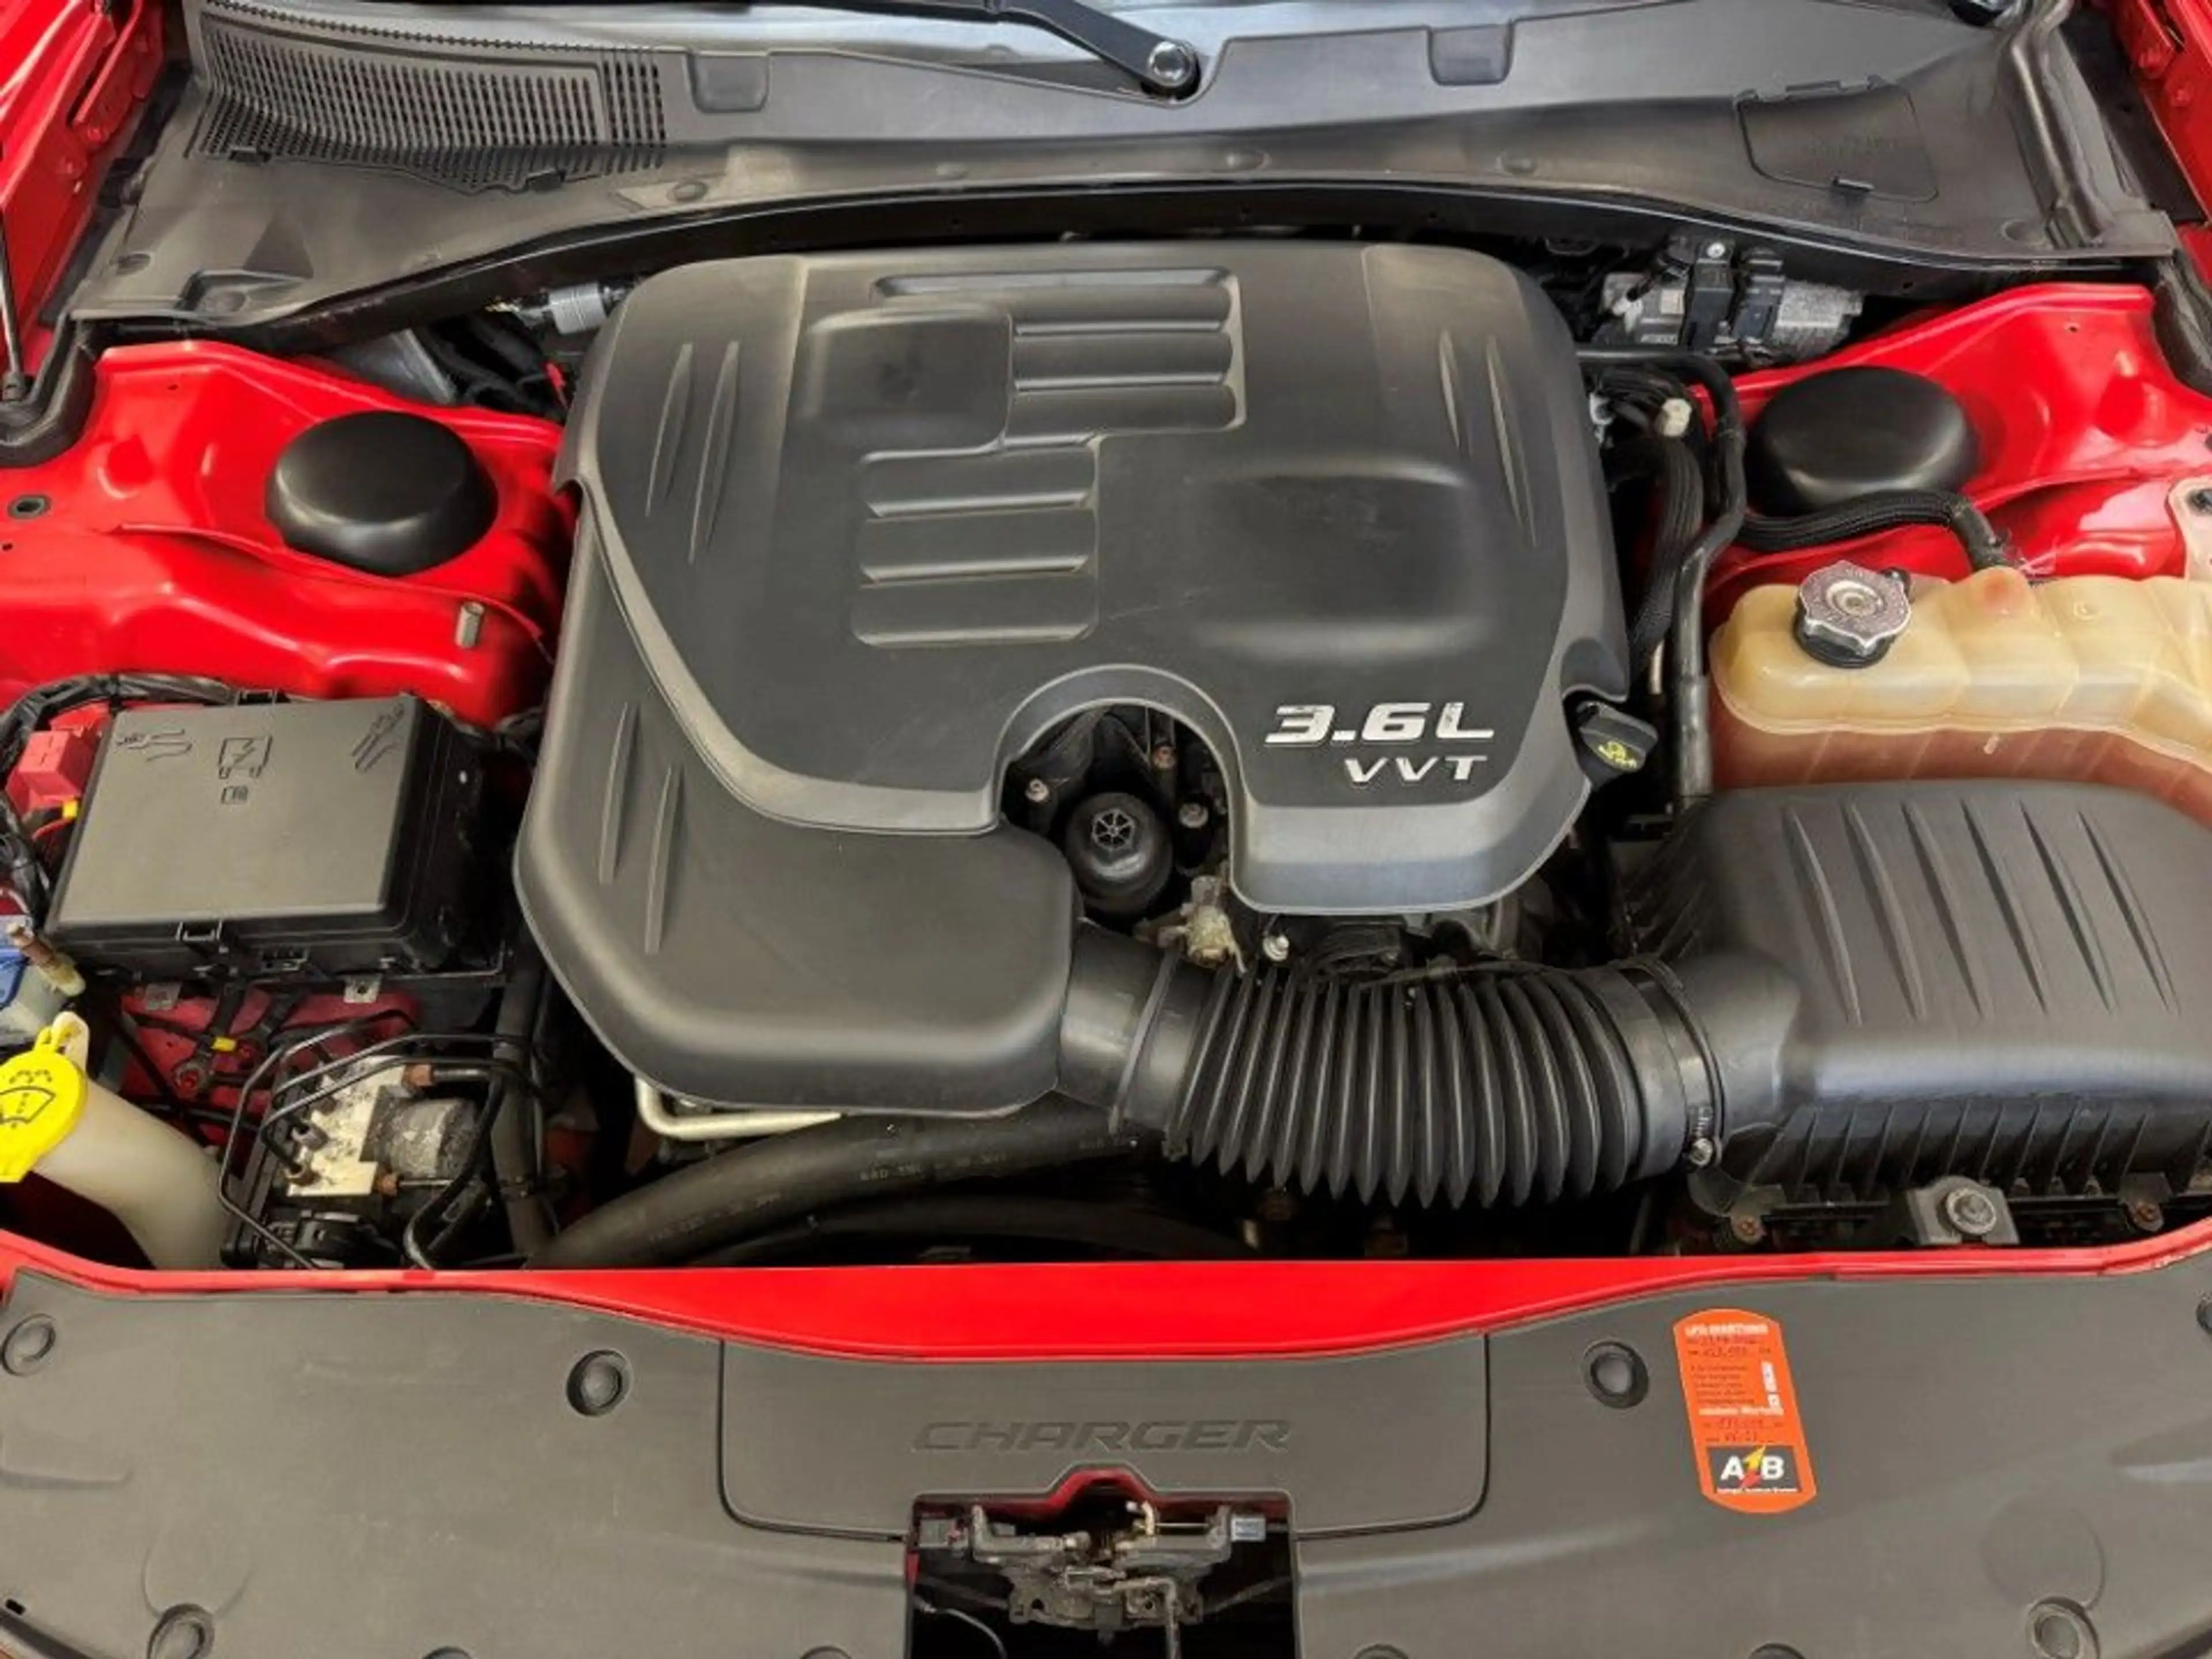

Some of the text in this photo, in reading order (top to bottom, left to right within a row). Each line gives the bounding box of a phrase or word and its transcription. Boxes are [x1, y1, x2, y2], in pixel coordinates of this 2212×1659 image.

[1264, 701, 1495, 746] 3.6L
[1344, 755, 1488, 784] VVT
[912, 1419, 1293, 1453] CHARGER
